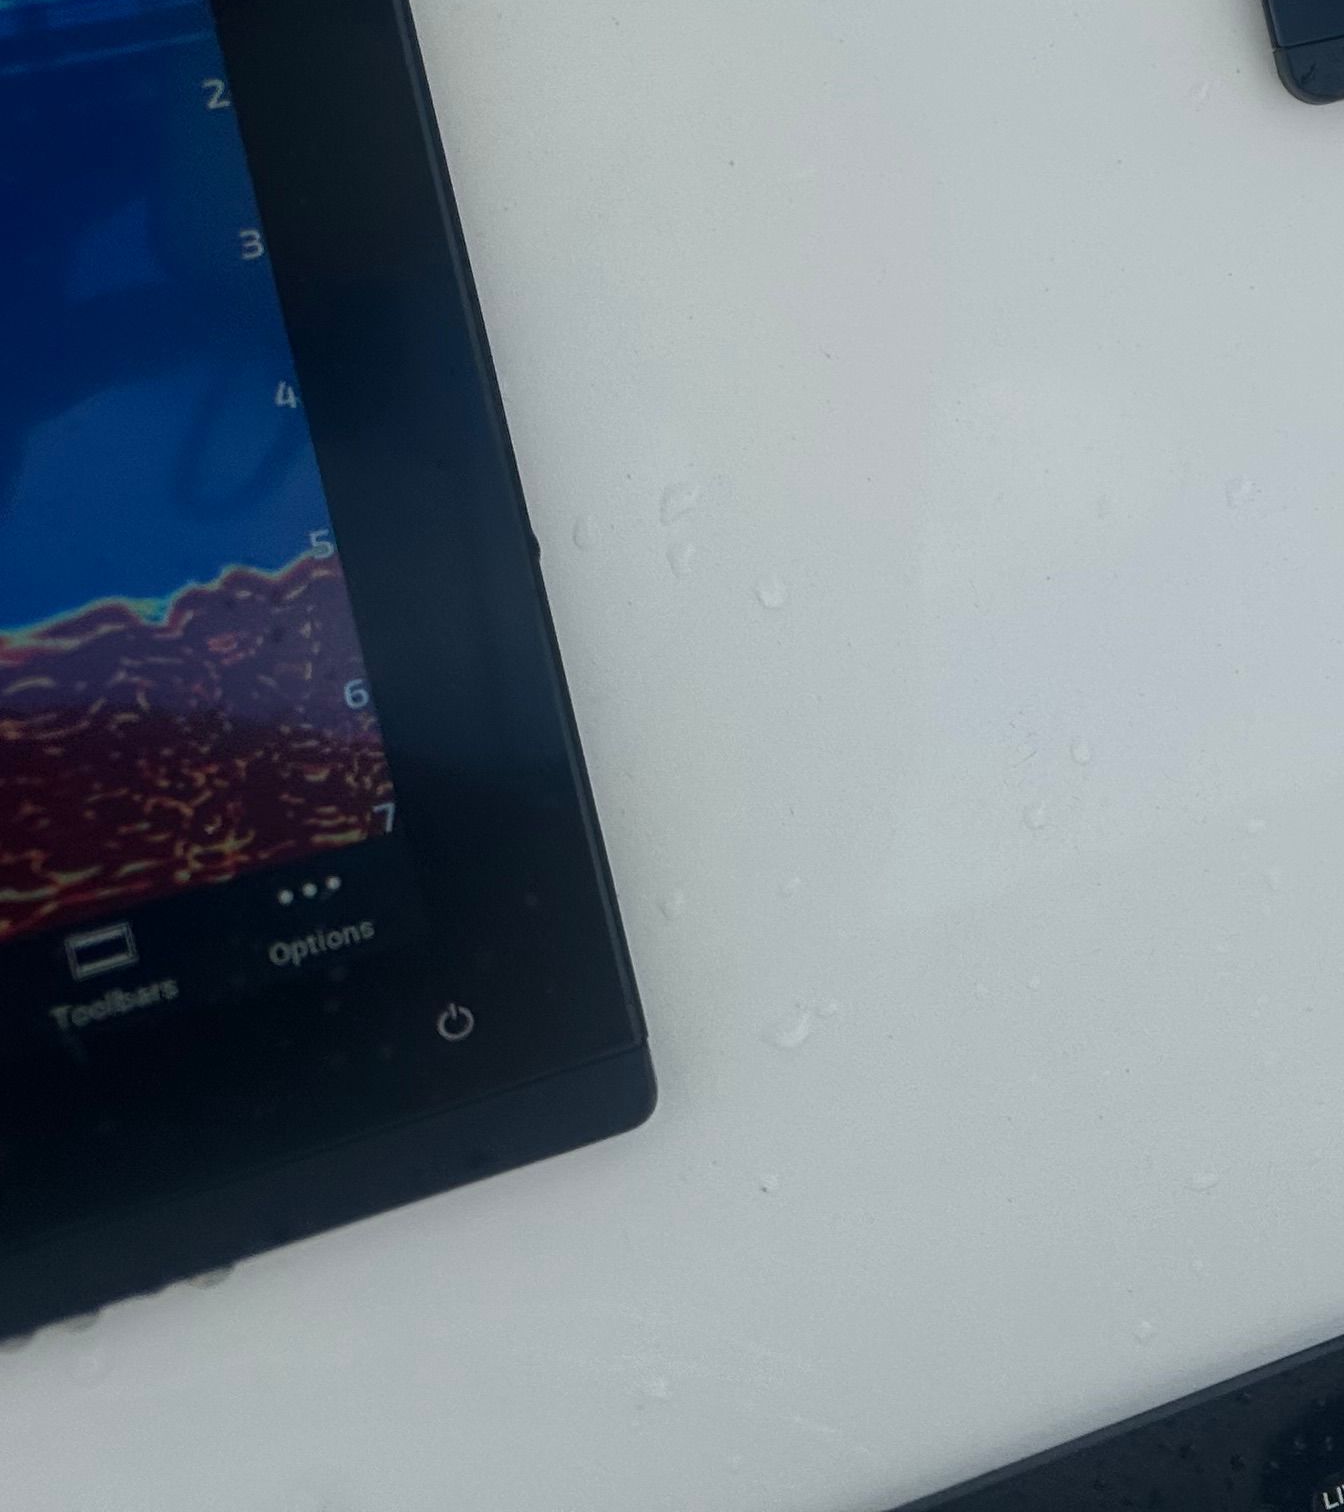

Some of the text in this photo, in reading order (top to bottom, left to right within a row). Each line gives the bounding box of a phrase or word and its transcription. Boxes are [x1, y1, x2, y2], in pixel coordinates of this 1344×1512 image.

[203, 78, 231, 110] 2
[239, 229, 264, 260] 3
[276, 381, 297, 409] 4
[310, 530, 336, 560] 5
[344, 679, 371, 709] 6
[373, 802, 397, 833] 7
[269, 920, 376, 967] Options
[50, 978, 180, 1030] Toolbars
